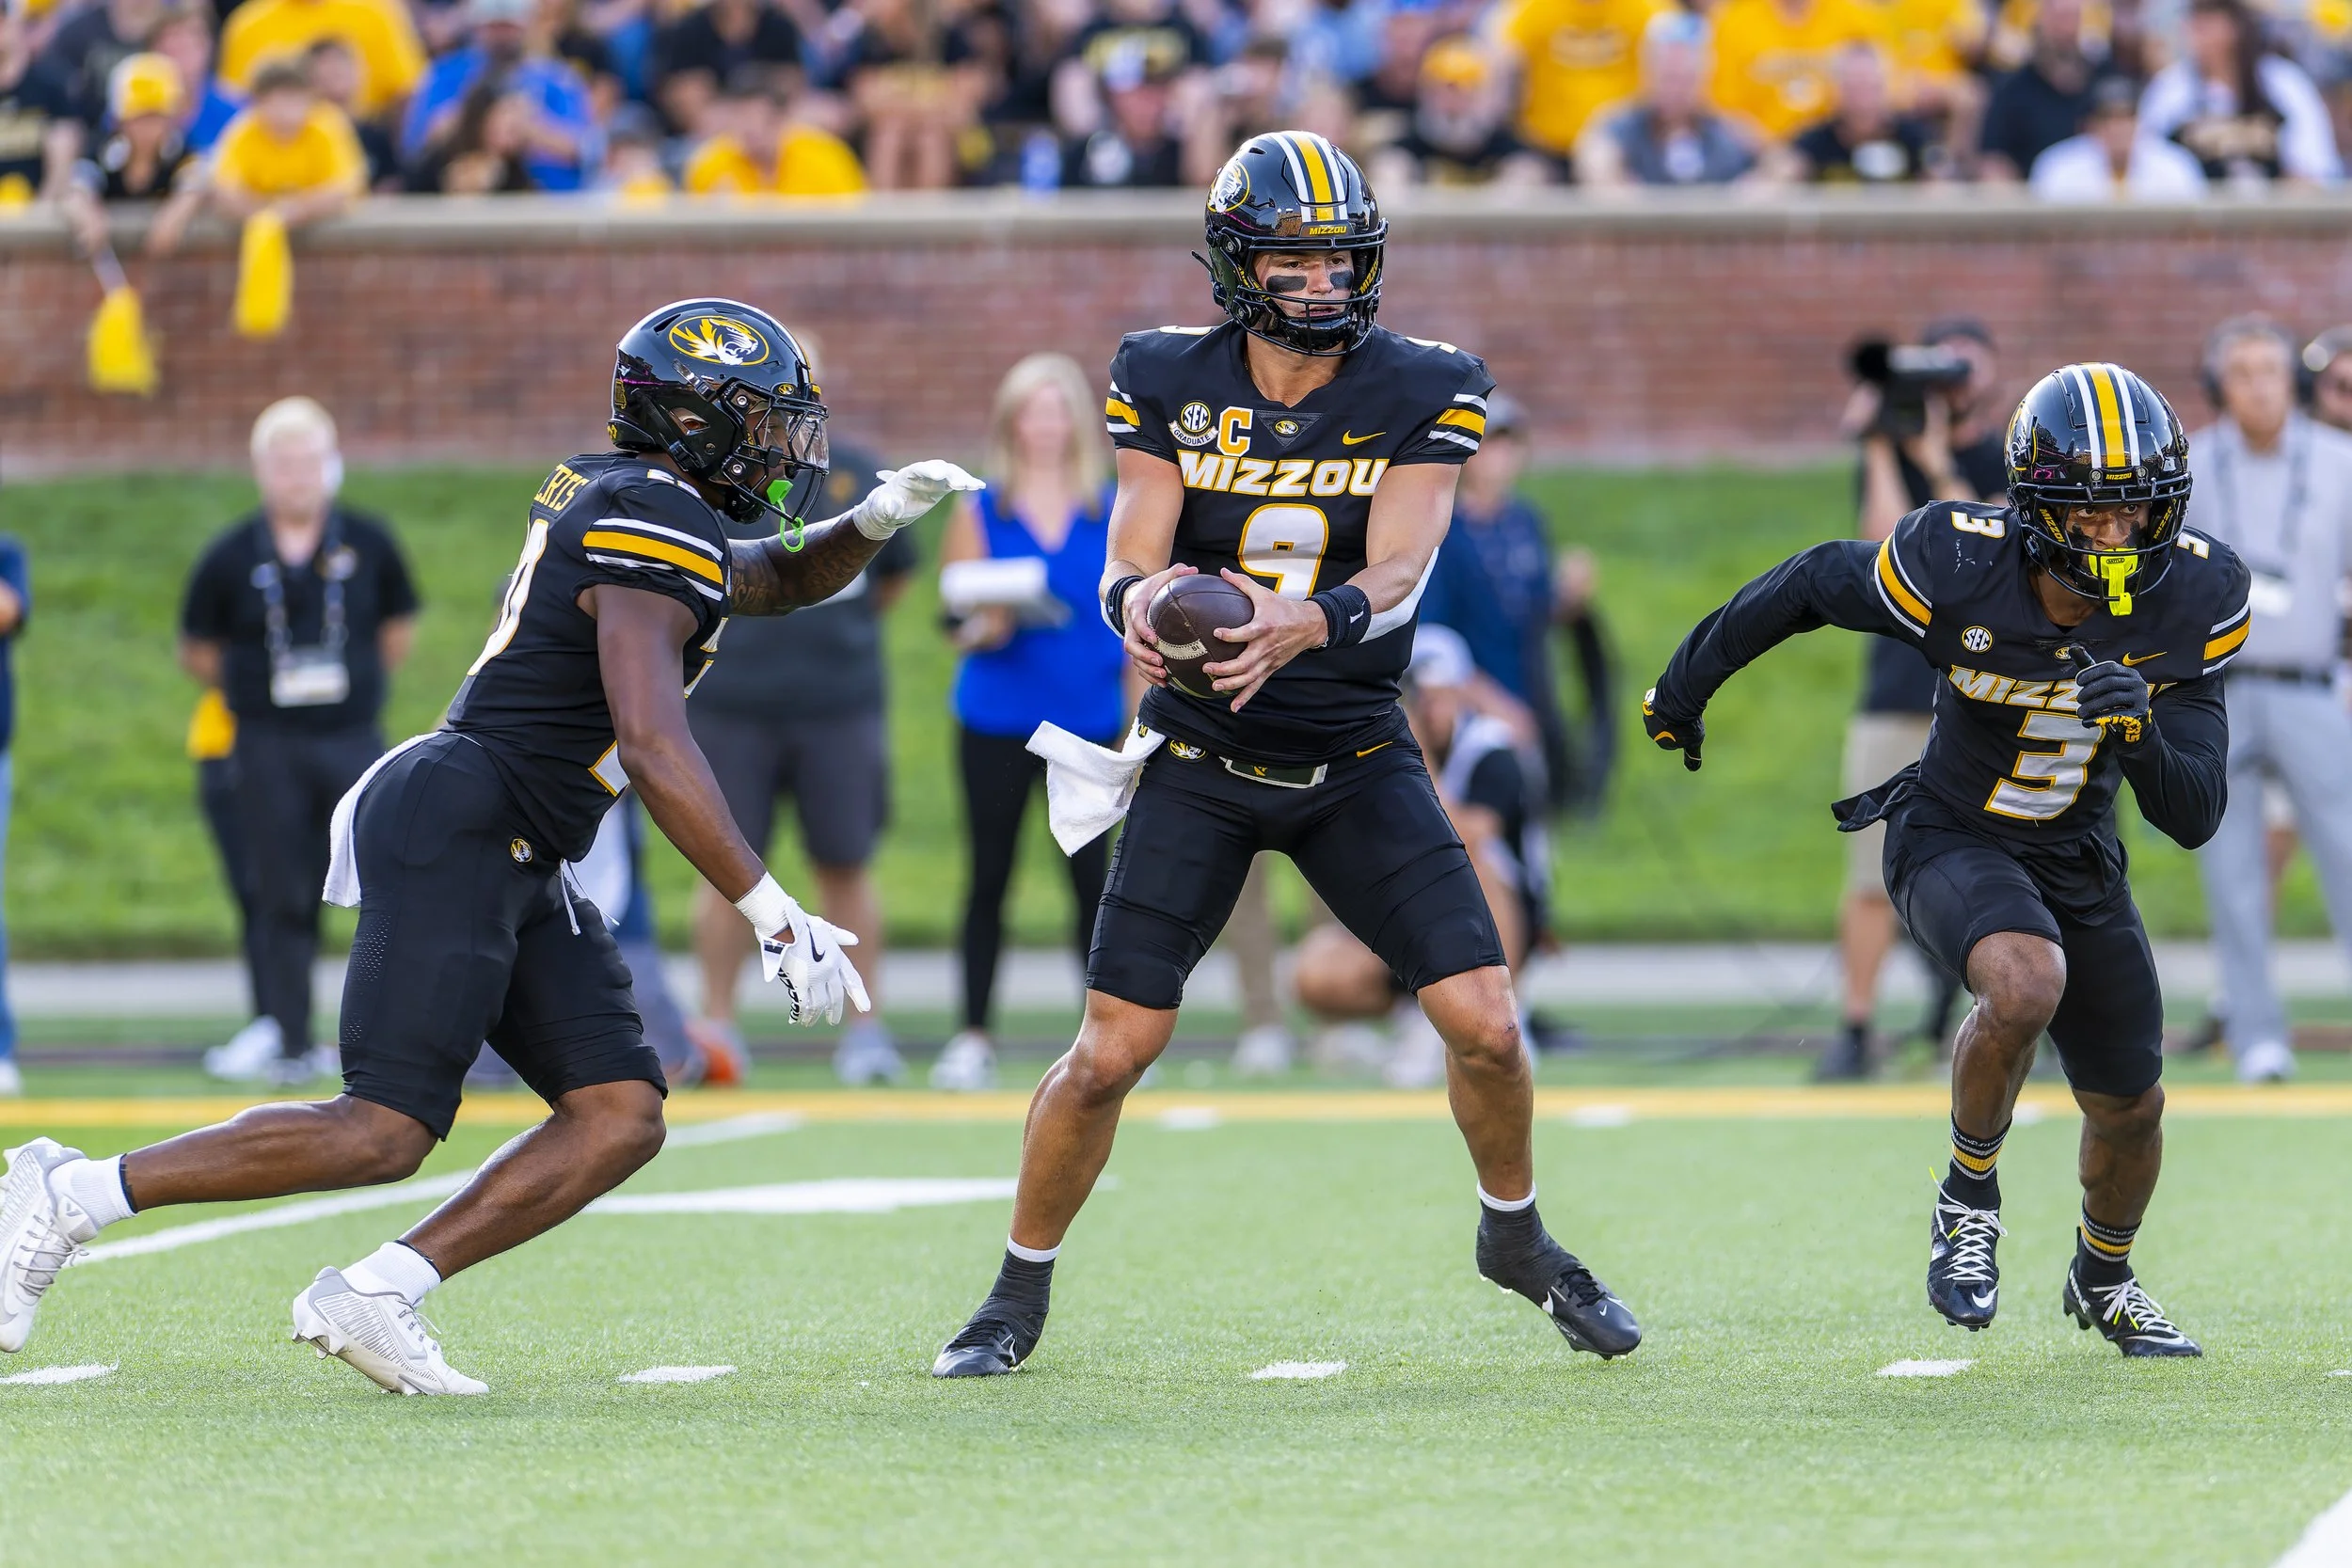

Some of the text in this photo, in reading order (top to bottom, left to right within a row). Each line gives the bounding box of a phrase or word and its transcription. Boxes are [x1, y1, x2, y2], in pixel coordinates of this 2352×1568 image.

[1309, 226, 1347, 235] MIZZOU
[1360, 258, 1379, 294] MIZZO
[1184, 404, 1209, 430] SEC
[1216, 406, 1254, 457] C
[1173, 429, 1211, 445] GRADUATE
[1177, 449, 1391, 498] MIZZOU
[1950, 511, 2006, 539] 3
[1237, 503, 1329, 602] 9
[1964, 627, 1991, 651] SEC
[1948, 664, 2178, 712] MIZZ
[1983, 709, 2107, 821] 3
